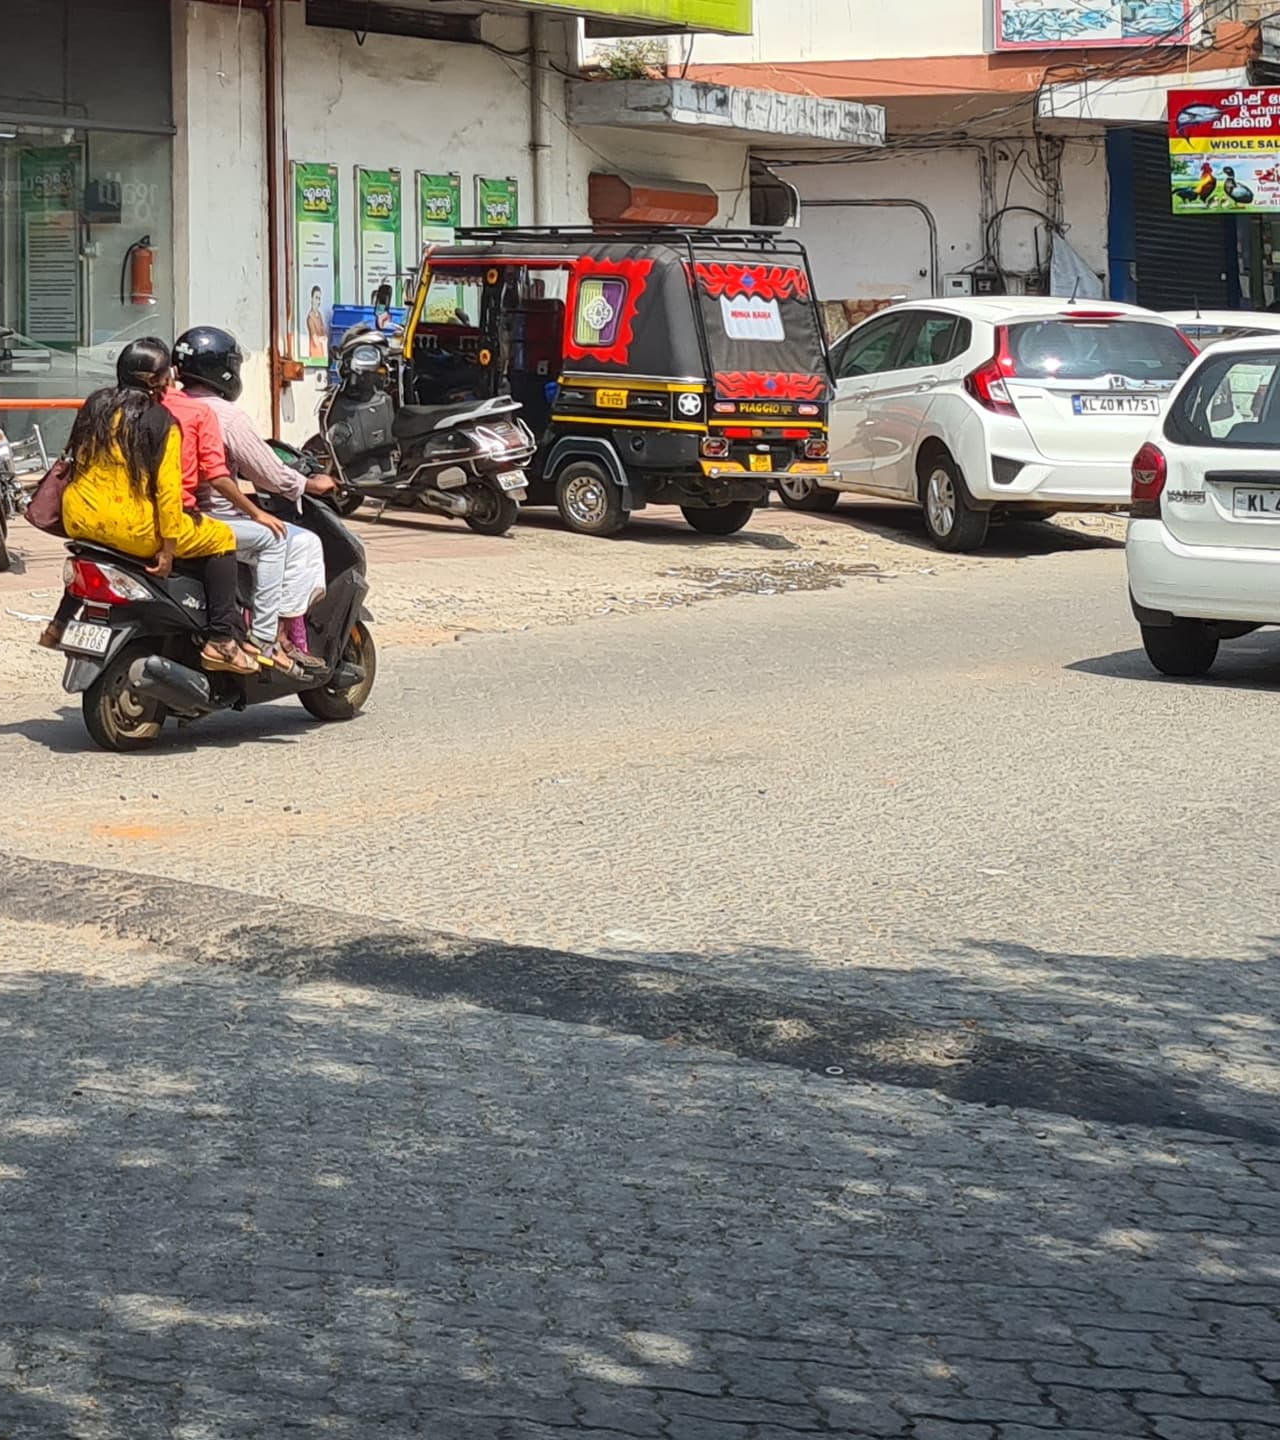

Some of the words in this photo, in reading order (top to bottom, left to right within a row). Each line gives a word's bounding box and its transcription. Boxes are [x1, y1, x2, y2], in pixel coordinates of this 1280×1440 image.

[1210, 140, 1254, 150] WHOLE
[1257, 140, 1280, 149] SAL
[740, 403, 780, 414] PIAGGIO
[1081, 399, 1097, 411] KL
[1100, 399, 1114, 411] 40
[1126, 399, 1156, 411] 1751
[1247, 494, 1270, 512] KL
